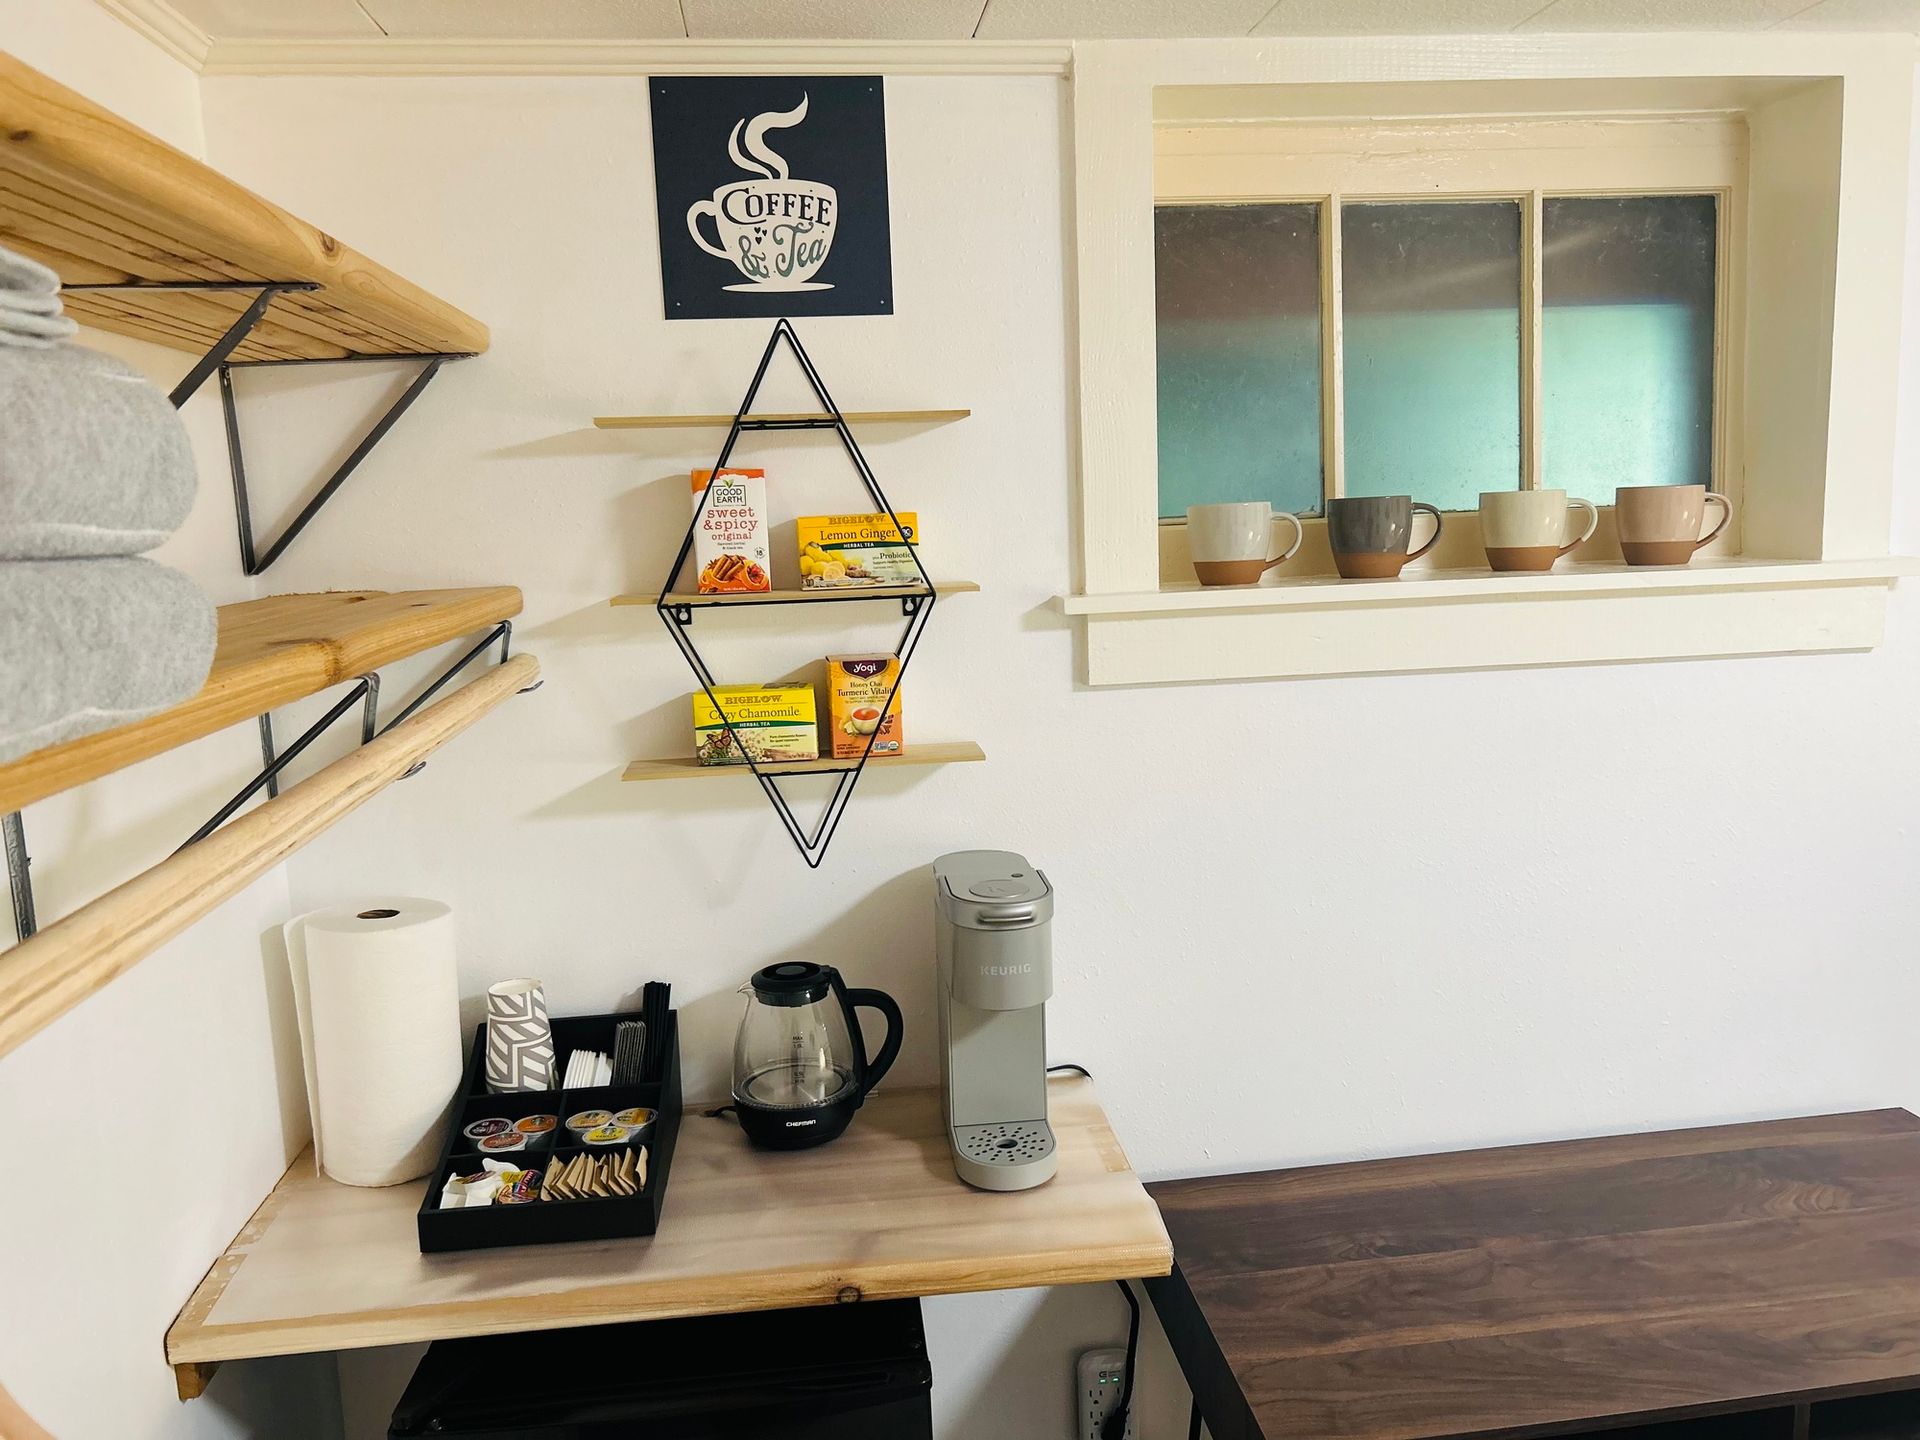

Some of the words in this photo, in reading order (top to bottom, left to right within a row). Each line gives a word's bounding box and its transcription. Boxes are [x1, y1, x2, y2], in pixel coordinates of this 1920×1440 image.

[721, 187, 832, 227] COFFEE
[738, 235, 770, 279] &
[772, 222, 827, 278] Tea
[716, 488, 742, 496] GOOD
[716, 496, 743, 504] EARTH
[707, 507, 755, 519] sweet
[828, 514, 886, 526] BIGELOW
[711, 532, 752, 542] original
[820, 530, 857, 541] Lemon
[860, 528, 897, 541] Ginger
[880, 551, 912, 560] Probiotic
[837, 689, 868, 697] Turmeric
[871, 687, 892, 695] Vitalit
[724, 695, 782, 705] BIGELOW
[738, 706, 800, 719] Chamomile
[980, 963, 1032, 976] KEURIG
[786, 1119, 816, 1127] CHEFMAN
